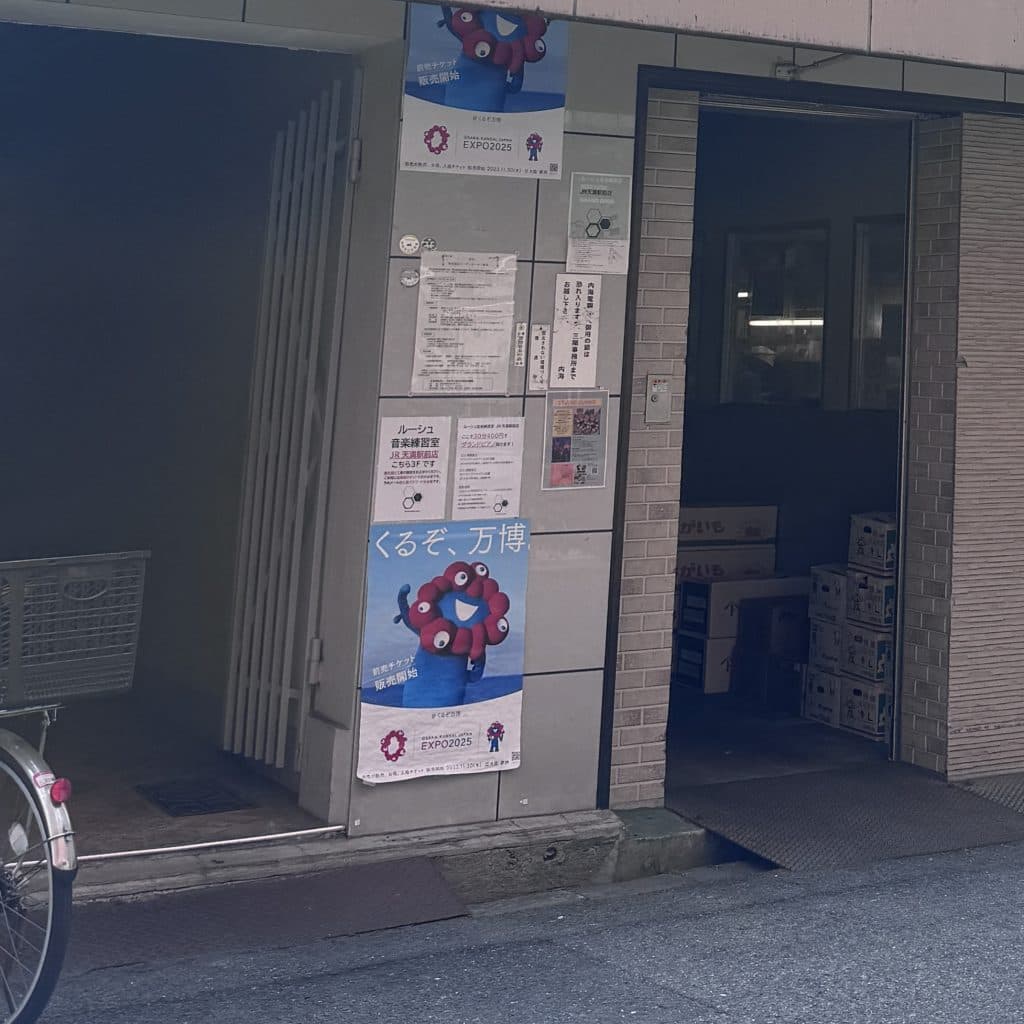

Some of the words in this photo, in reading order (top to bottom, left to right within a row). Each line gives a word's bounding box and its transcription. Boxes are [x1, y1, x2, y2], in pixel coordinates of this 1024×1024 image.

[463, 140, 512, 152] EXPO2025
[398, 424, 434, 434] ルーシュ
[391, 437, 440, 448] 音楽練習室
[375, 668, 418, 692] 販売開始
[421, 737, 472, 750] EXPO2025
